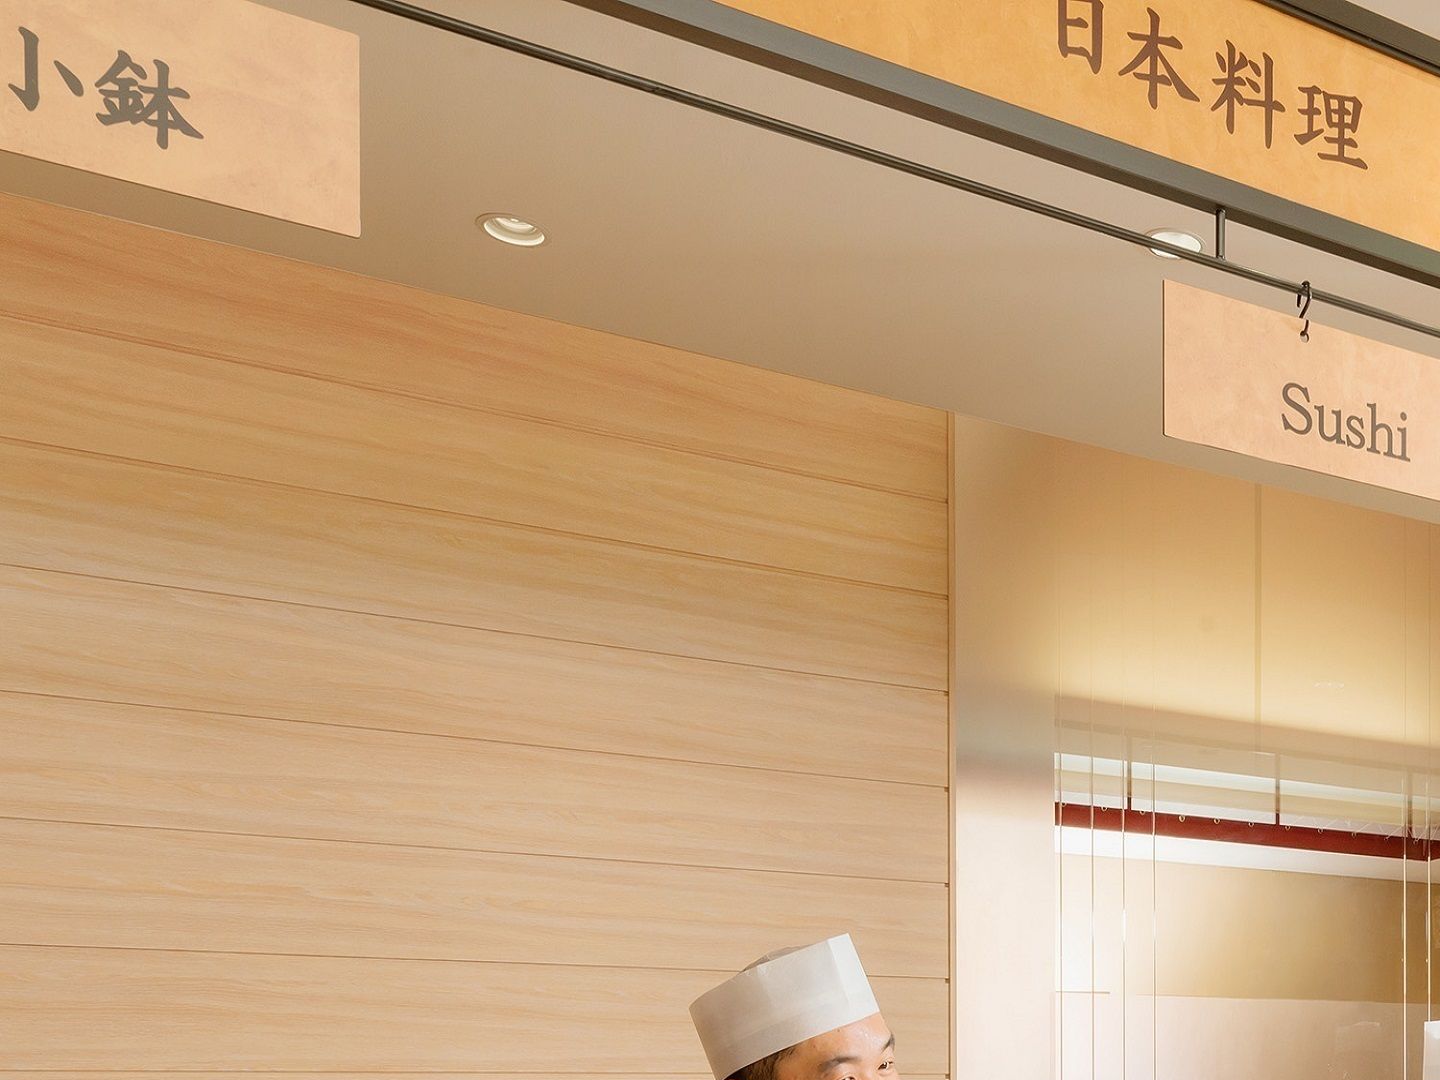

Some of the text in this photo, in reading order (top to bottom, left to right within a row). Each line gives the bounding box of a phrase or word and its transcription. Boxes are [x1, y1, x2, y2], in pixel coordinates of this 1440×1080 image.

[8, 26, 204, 149] 小鉢
[1058, 0, 1368, 170] 日本料理
[1281, 382, 1411, 462] Sushi
